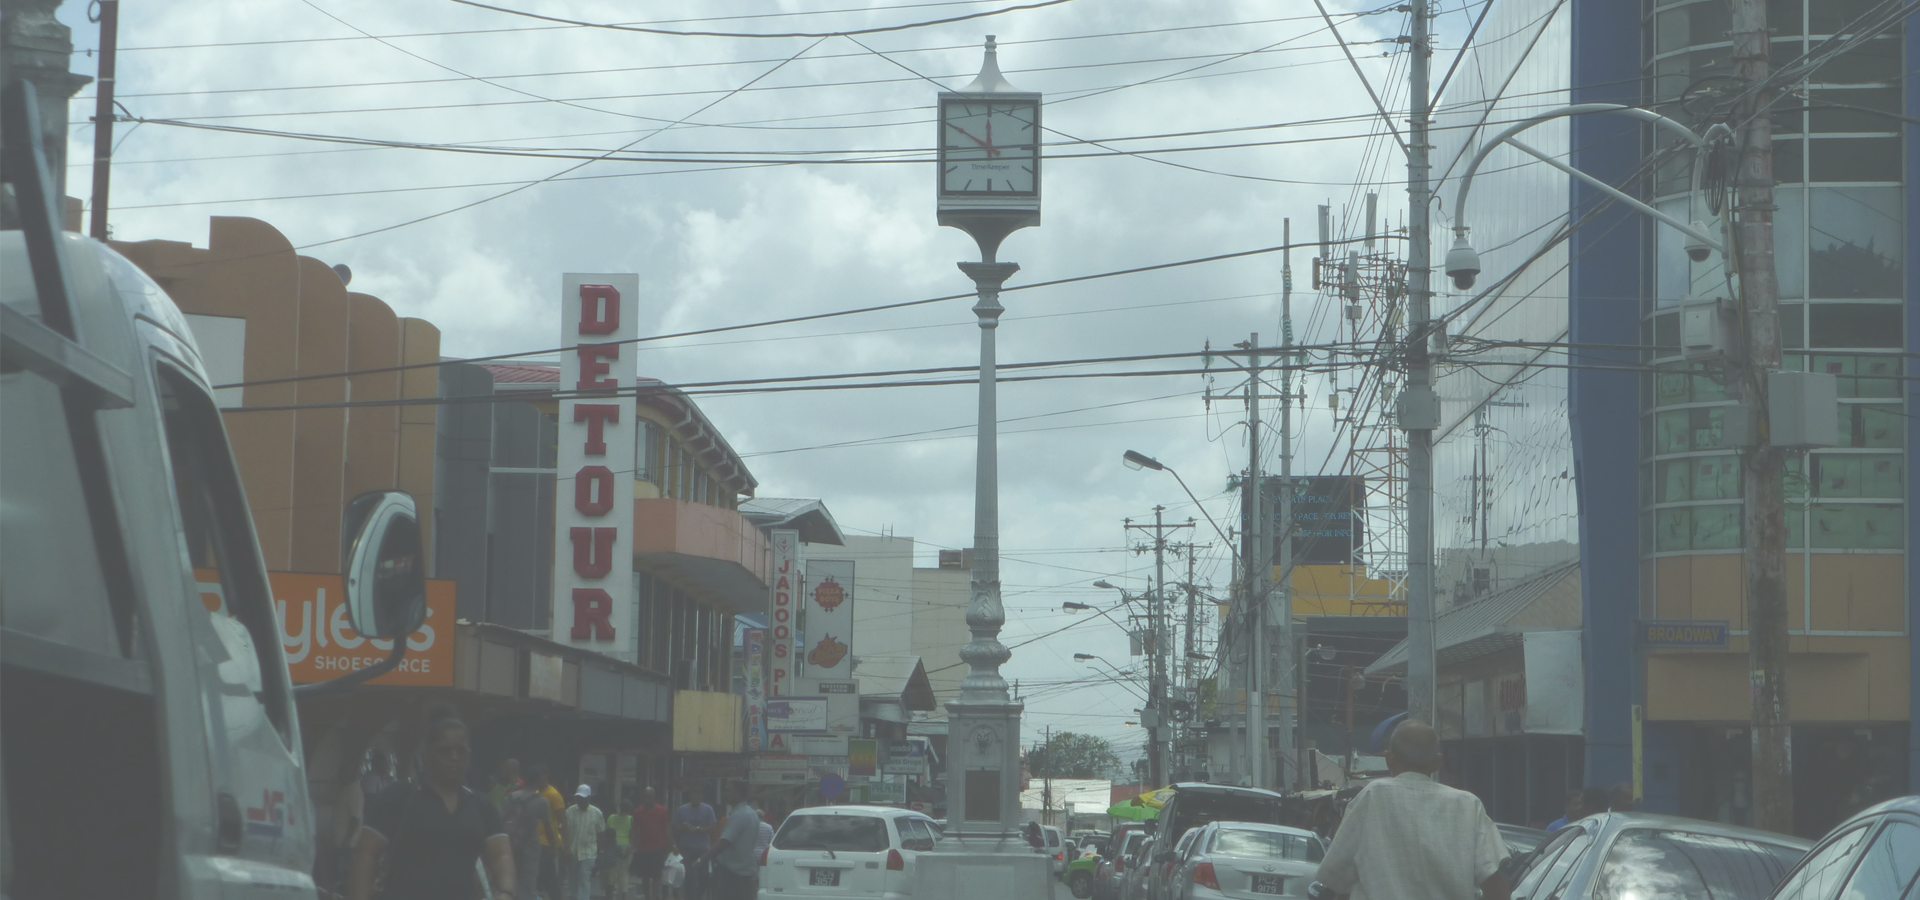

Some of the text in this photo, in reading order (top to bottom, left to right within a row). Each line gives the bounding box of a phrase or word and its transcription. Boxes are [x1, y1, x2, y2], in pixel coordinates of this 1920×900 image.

[570, 283, 620, 641] DETOUR
[195, 582, 435, 664] Pyles
[1648, 627, 1720, 642] BROADWAY
[771, 560, 790, 748] JADOO'S PLA
[315, 655, 431, 673] SHOESRCE
[815, 869, 835, 878] HCN
[1258, 875, 1278, 885] PCZ
[815, 877, 833, 886] 3157
[1257, 884, 1277, 894] 9179
